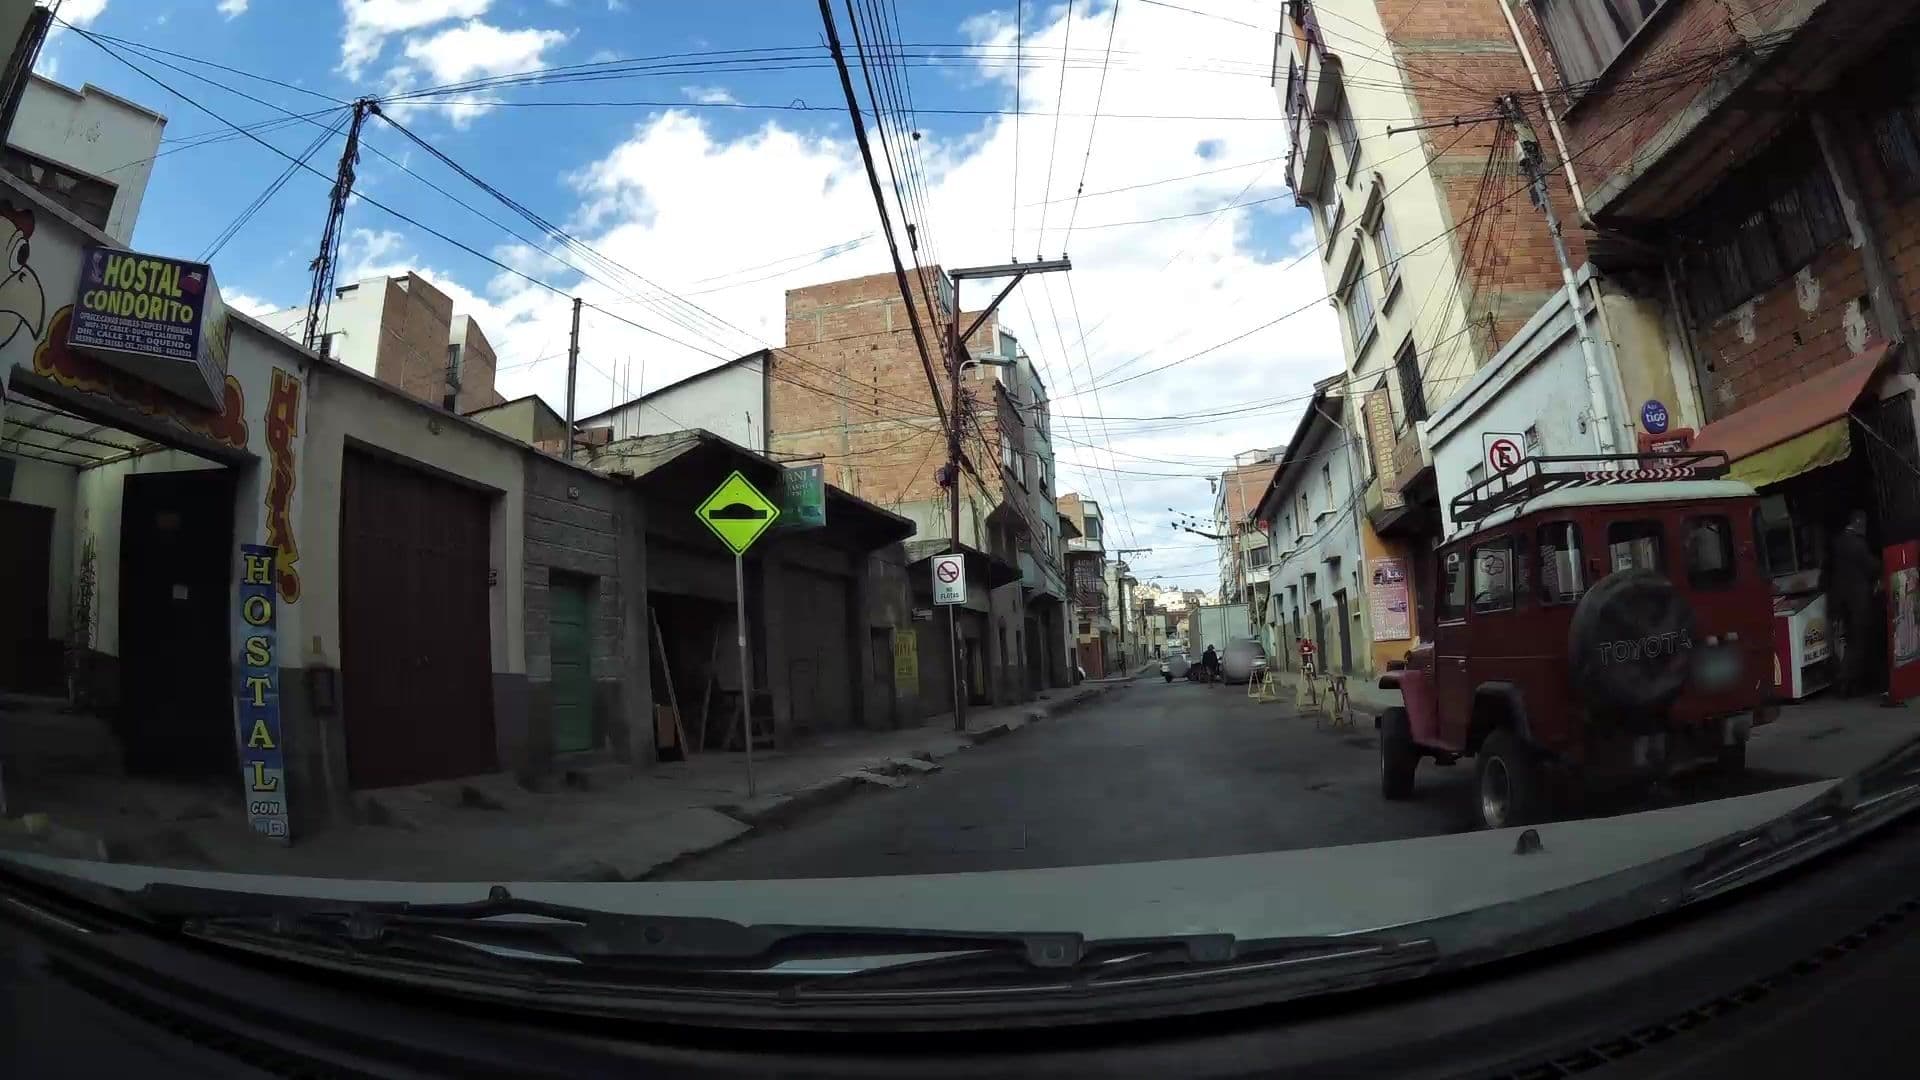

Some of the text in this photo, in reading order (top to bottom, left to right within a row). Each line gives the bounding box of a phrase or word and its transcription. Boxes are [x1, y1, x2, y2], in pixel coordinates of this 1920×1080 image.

[103, 254, 182, 297] HOSTAL
[83, 290, 193, 323] CONDORITO
[77, 326, 94, 336] DIR.
[96, 329, 123, 340] CALLE
[145, 336, 191, 350] OQUENDO
[1645, 410, 1666, 423] tigo
[1598, 627, 1695, 666] TOYOTA
[243, 555, 278, 793] HOSTAL
[250, 800, 280, 815] CON
